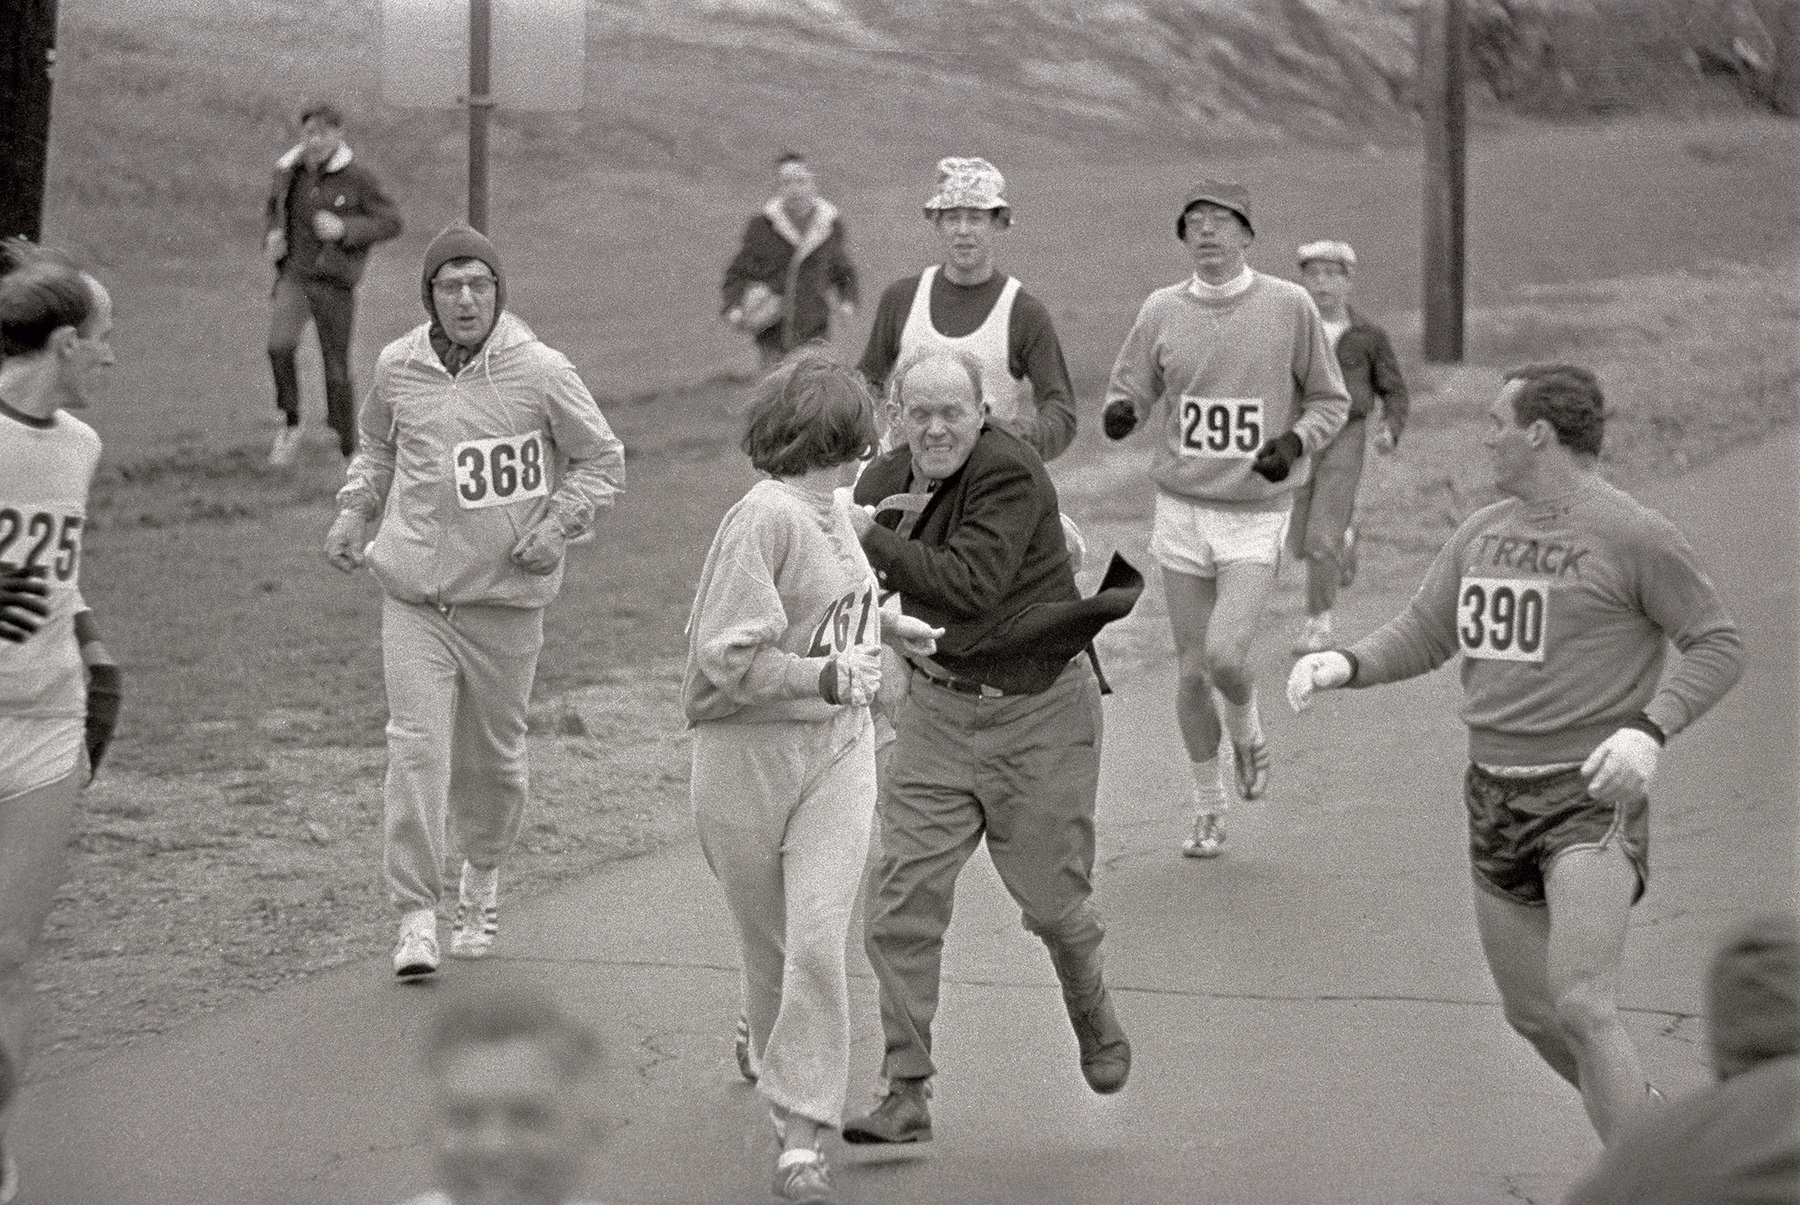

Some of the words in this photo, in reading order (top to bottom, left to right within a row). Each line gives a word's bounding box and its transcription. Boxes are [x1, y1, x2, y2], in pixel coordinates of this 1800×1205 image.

[1184, 402, 1260, 451] 295
[457, 438, 541, 501] 368
[1476, 534, 1589, 578] TRACK
[806, 585, 872, 657] 261
[1461, 585, 1543, 653] 390
